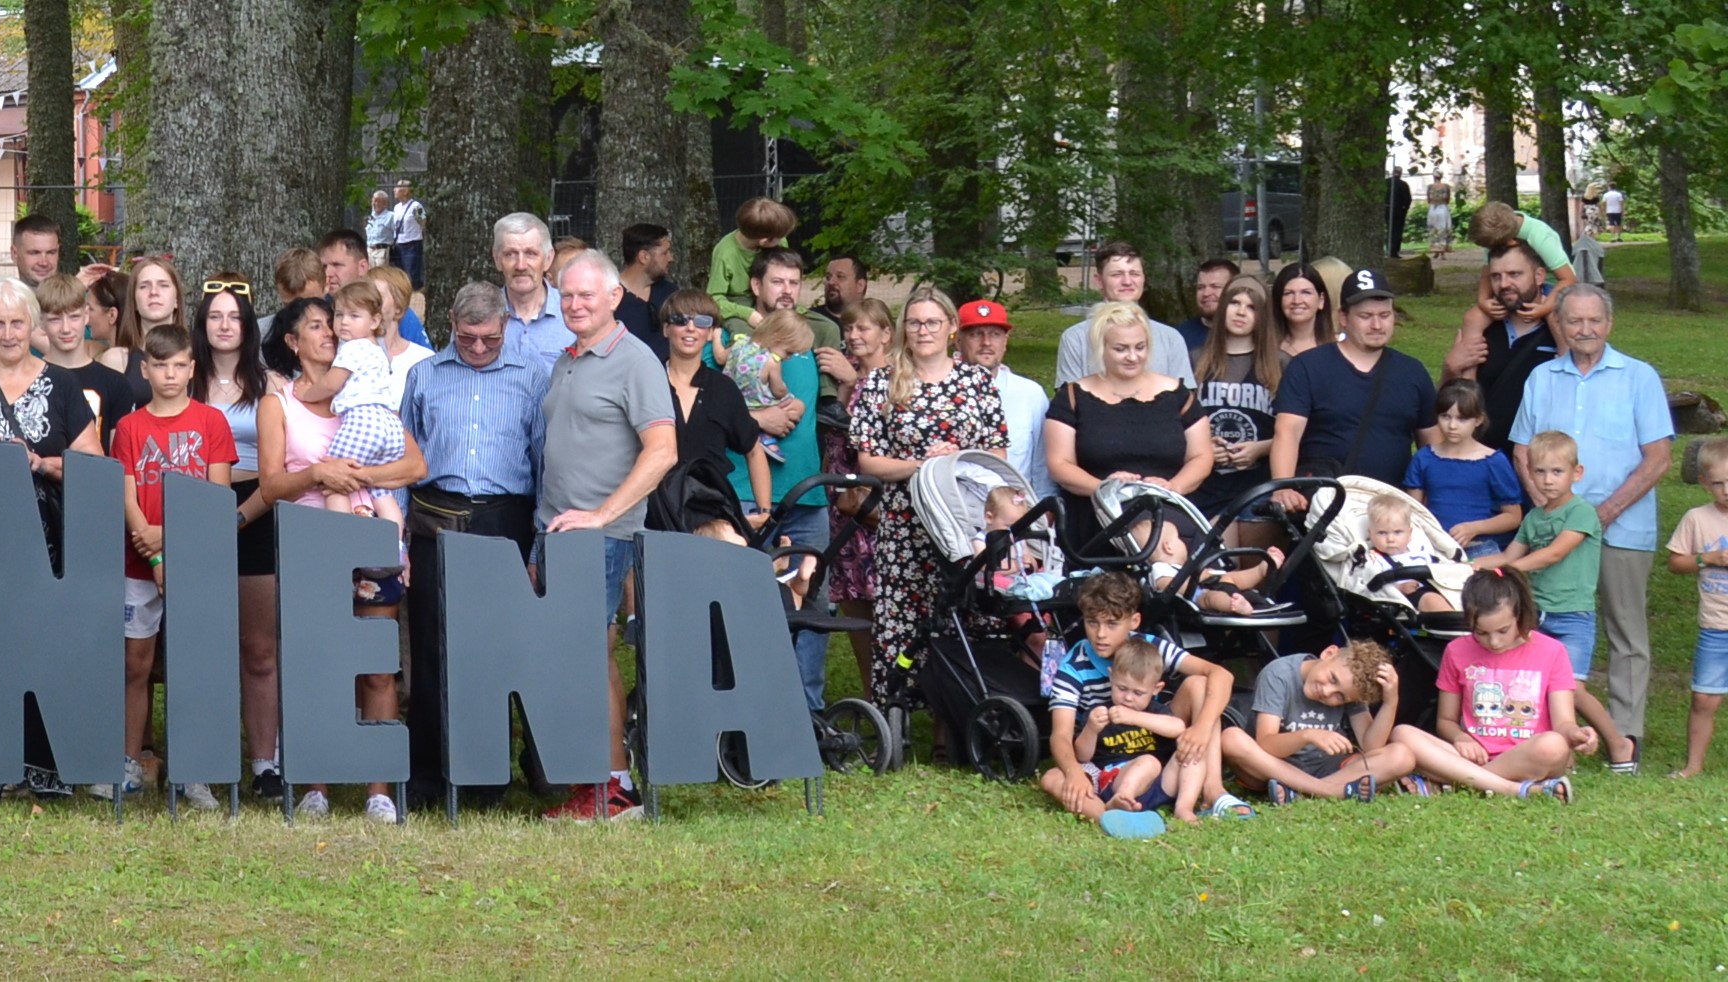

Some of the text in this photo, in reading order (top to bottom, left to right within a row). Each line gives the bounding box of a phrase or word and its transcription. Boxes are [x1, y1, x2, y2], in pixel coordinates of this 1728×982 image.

[1357, 269, 1375, 290] S
[1197, 381, 1275, 415] LIFORN
[1509, 728, 1535, 738] GIR
